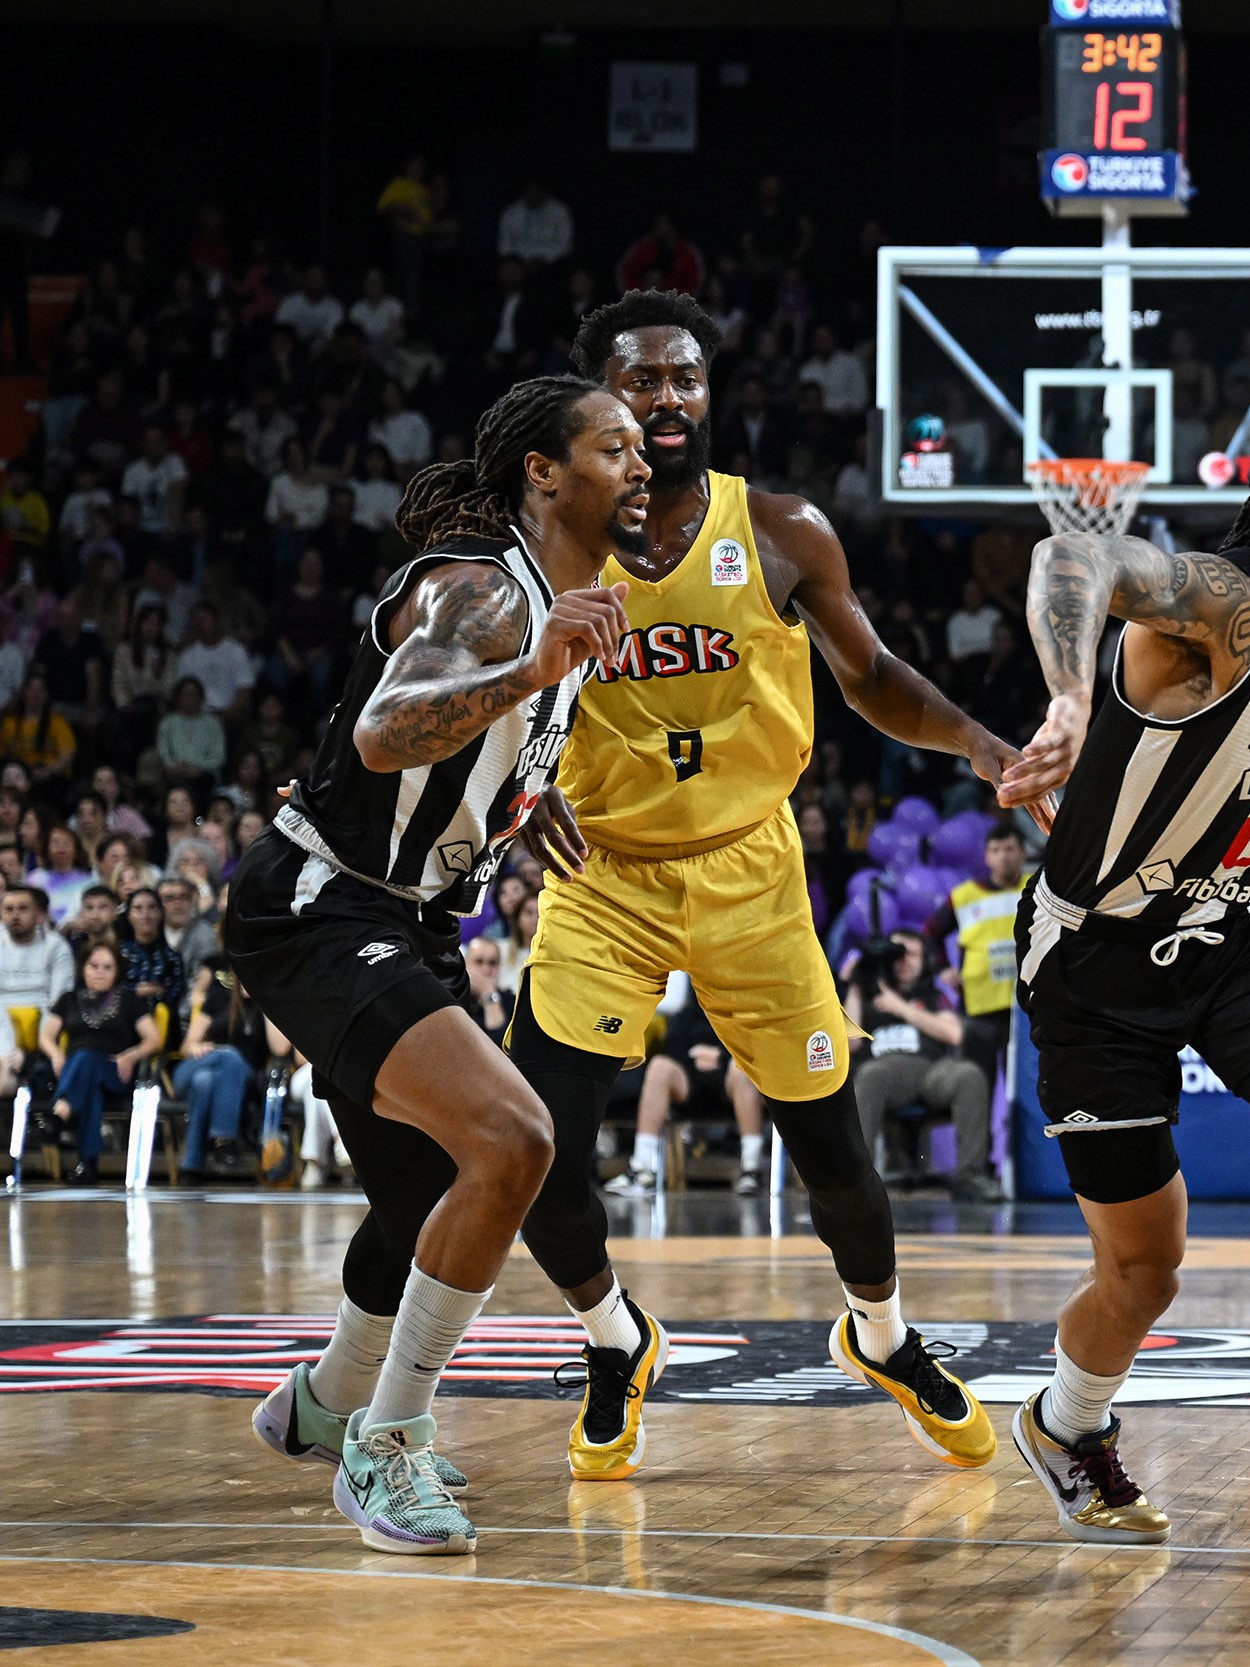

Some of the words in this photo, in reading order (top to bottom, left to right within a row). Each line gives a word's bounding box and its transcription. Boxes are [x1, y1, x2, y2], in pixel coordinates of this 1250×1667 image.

[1081, 33, 1162, 73] 3:42
[1093, 82, 1153, 150] 12
[598, 624, 737, 682] MSK
